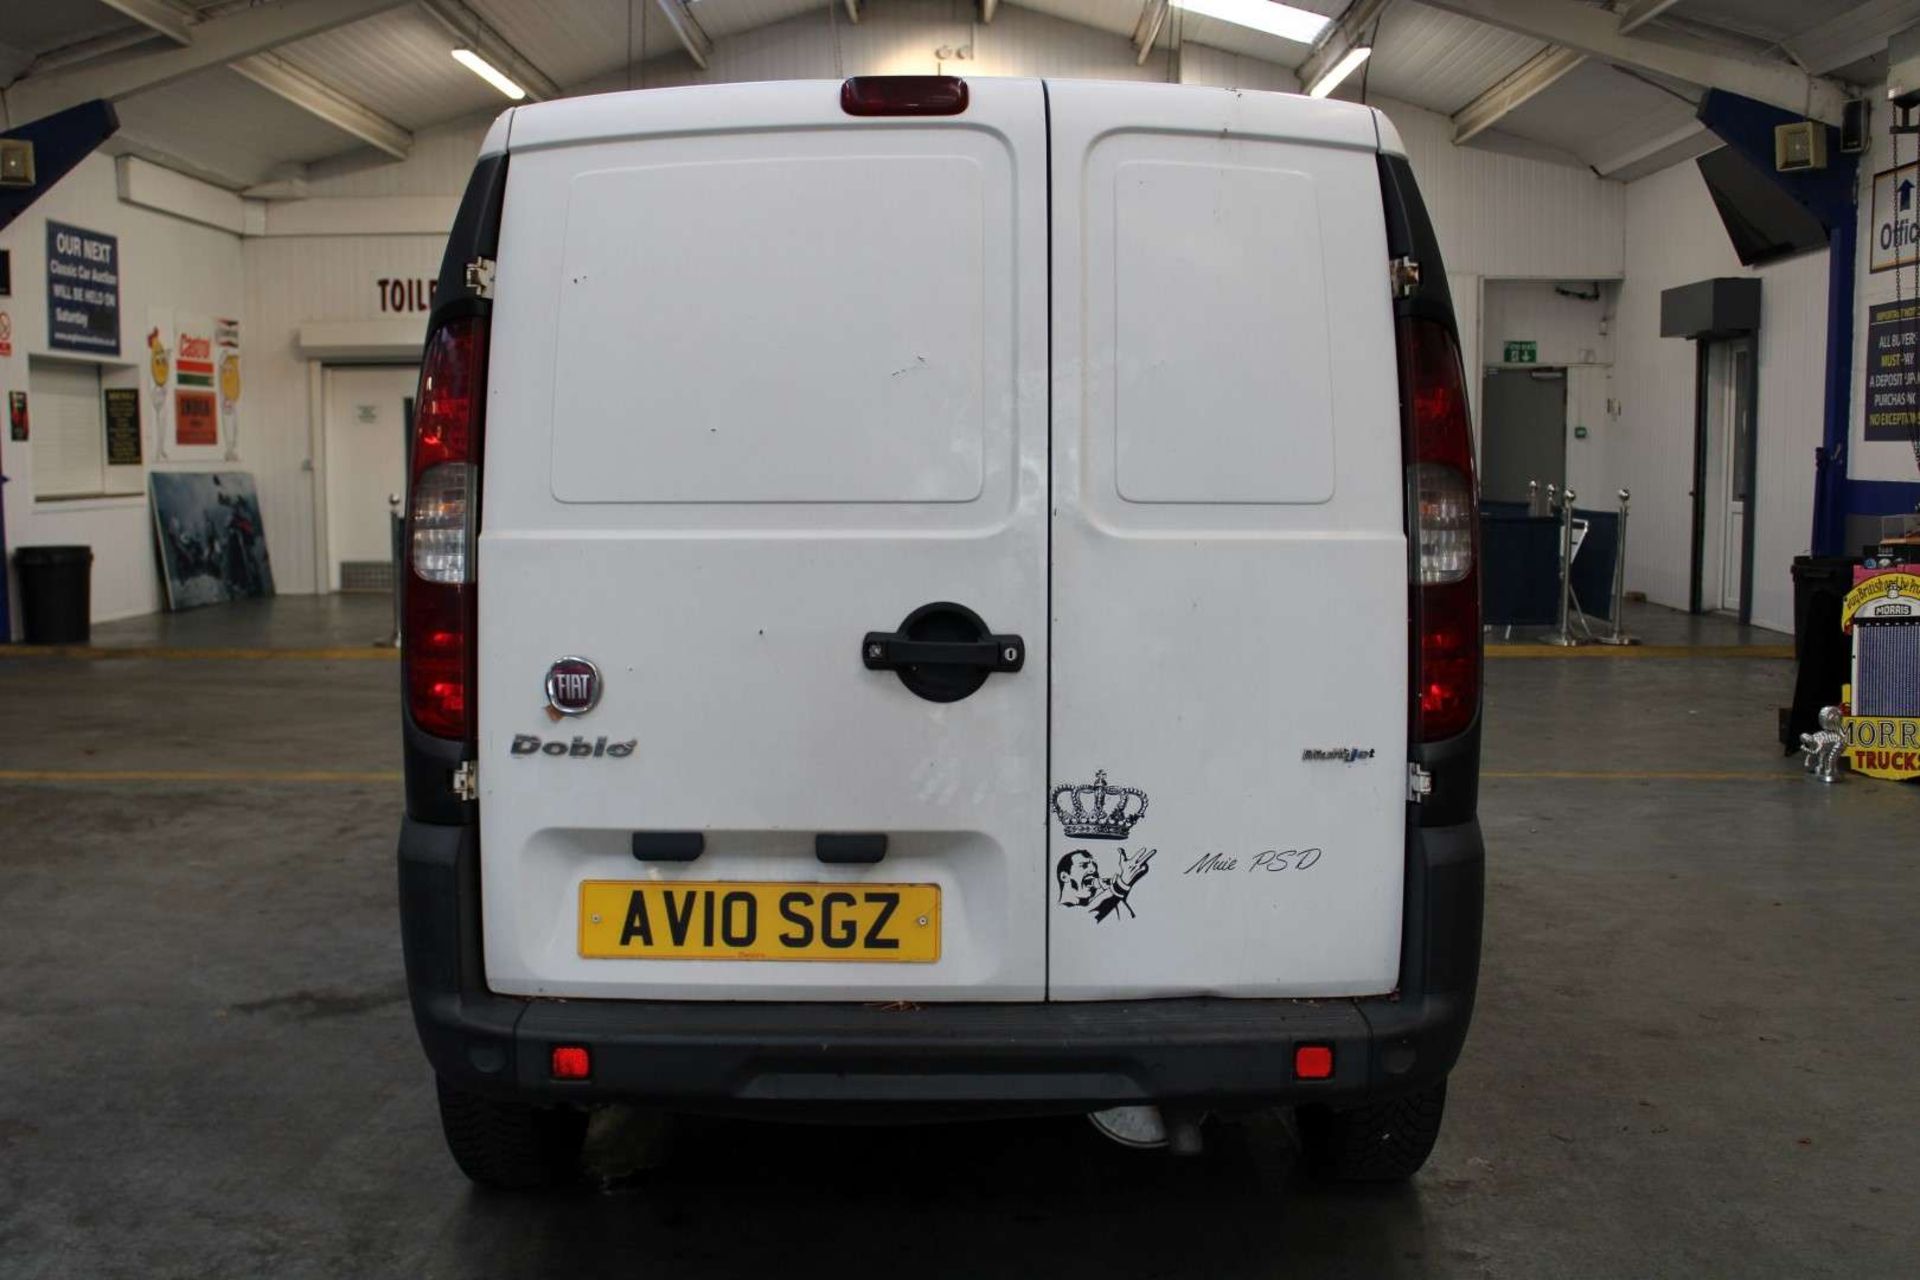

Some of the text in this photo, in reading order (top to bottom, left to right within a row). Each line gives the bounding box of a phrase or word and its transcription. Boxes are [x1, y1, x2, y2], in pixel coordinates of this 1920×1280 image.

[57, 232, 111, 263] OUR NEXT
[1875, 373, 1903, 388] DEPOSIT
[1875, 605, 1909, 615] MORRIS
[557, 674, 590, 699] FIAT
[1855, 751, 1920, 771] TRUCK
[1249, 848, 1322, 873] PSD
[619, 890, 900, 949] AV10 SGZ
